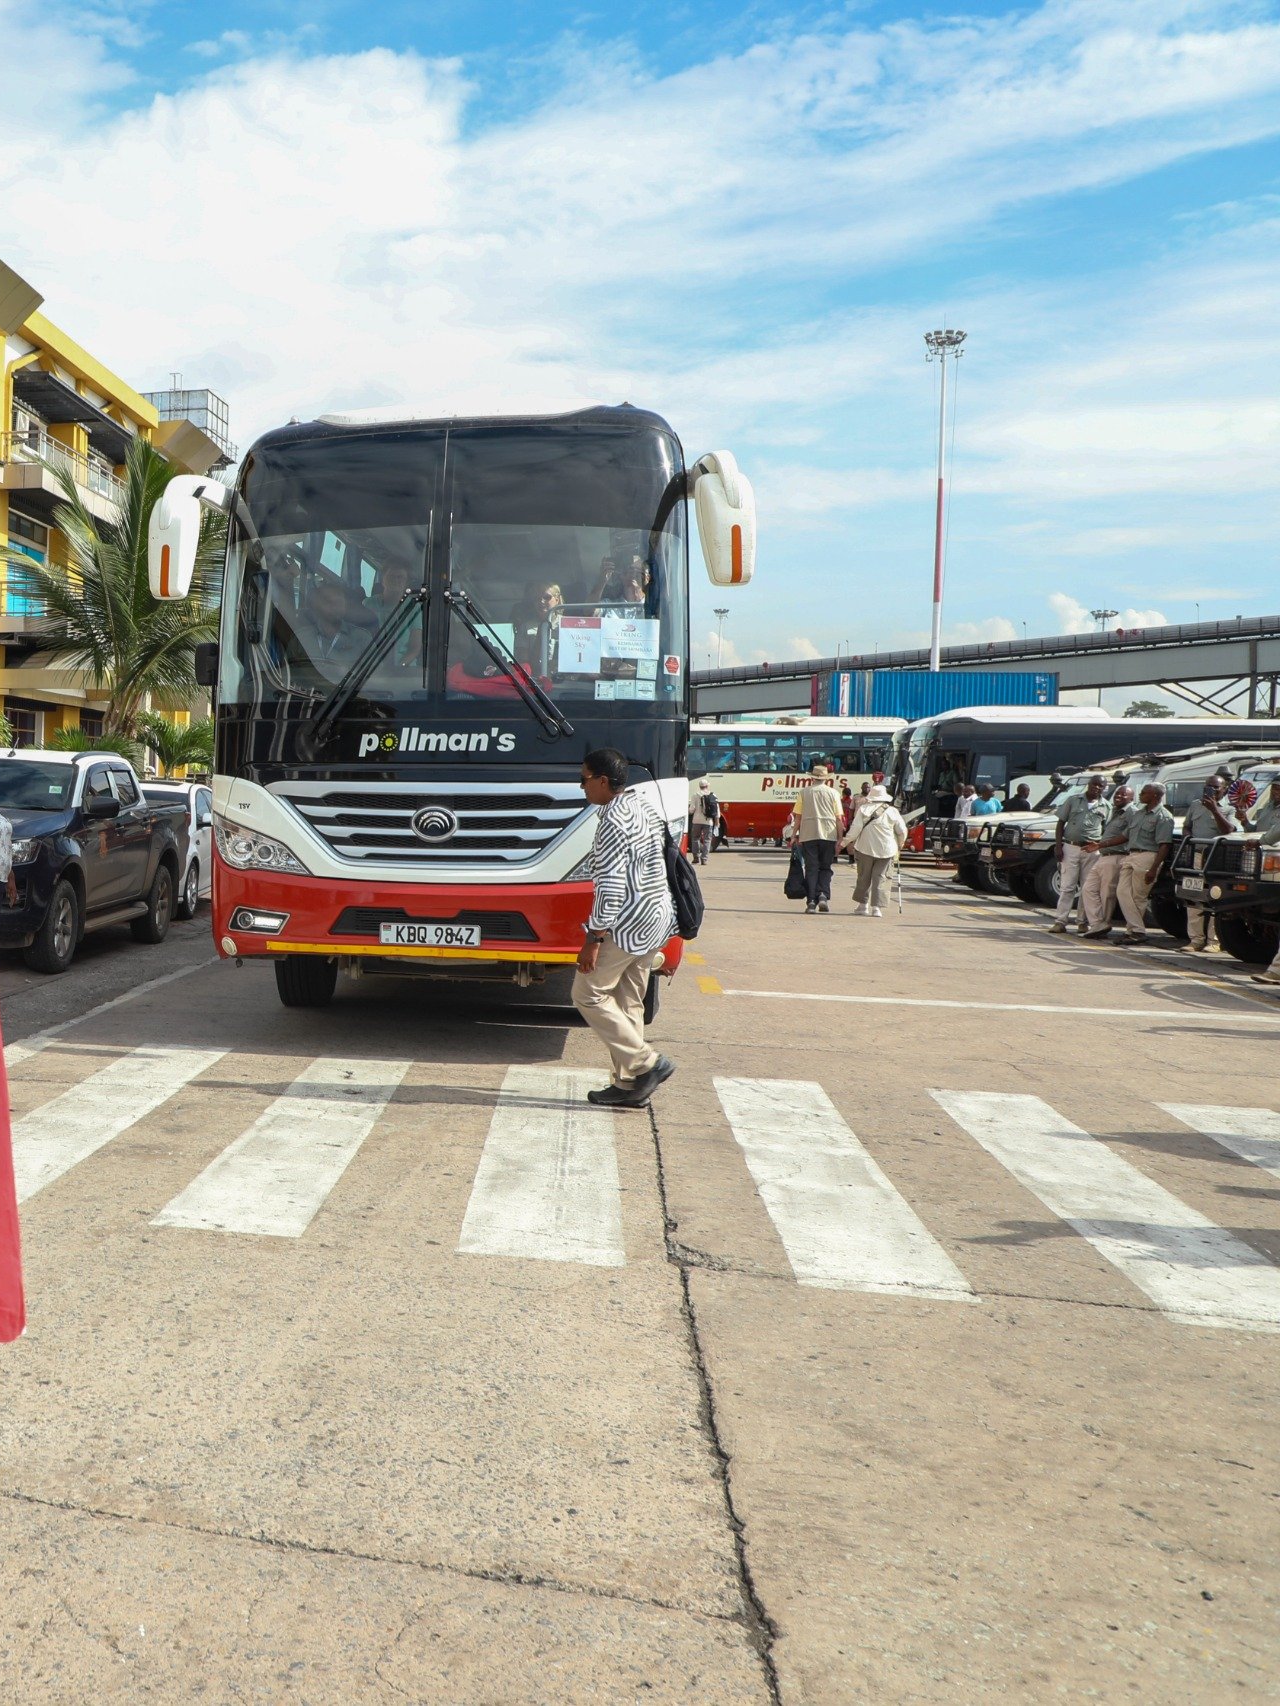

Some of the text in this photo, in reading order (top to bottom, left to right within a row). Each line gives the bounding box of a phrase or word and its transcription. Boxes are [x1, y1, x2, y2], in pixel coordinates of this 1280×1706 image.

[358, 727, 516, 758] pollman's
[761, 775, 848, 791] pollmn's
[434, 926, 475, 945] 984Z
